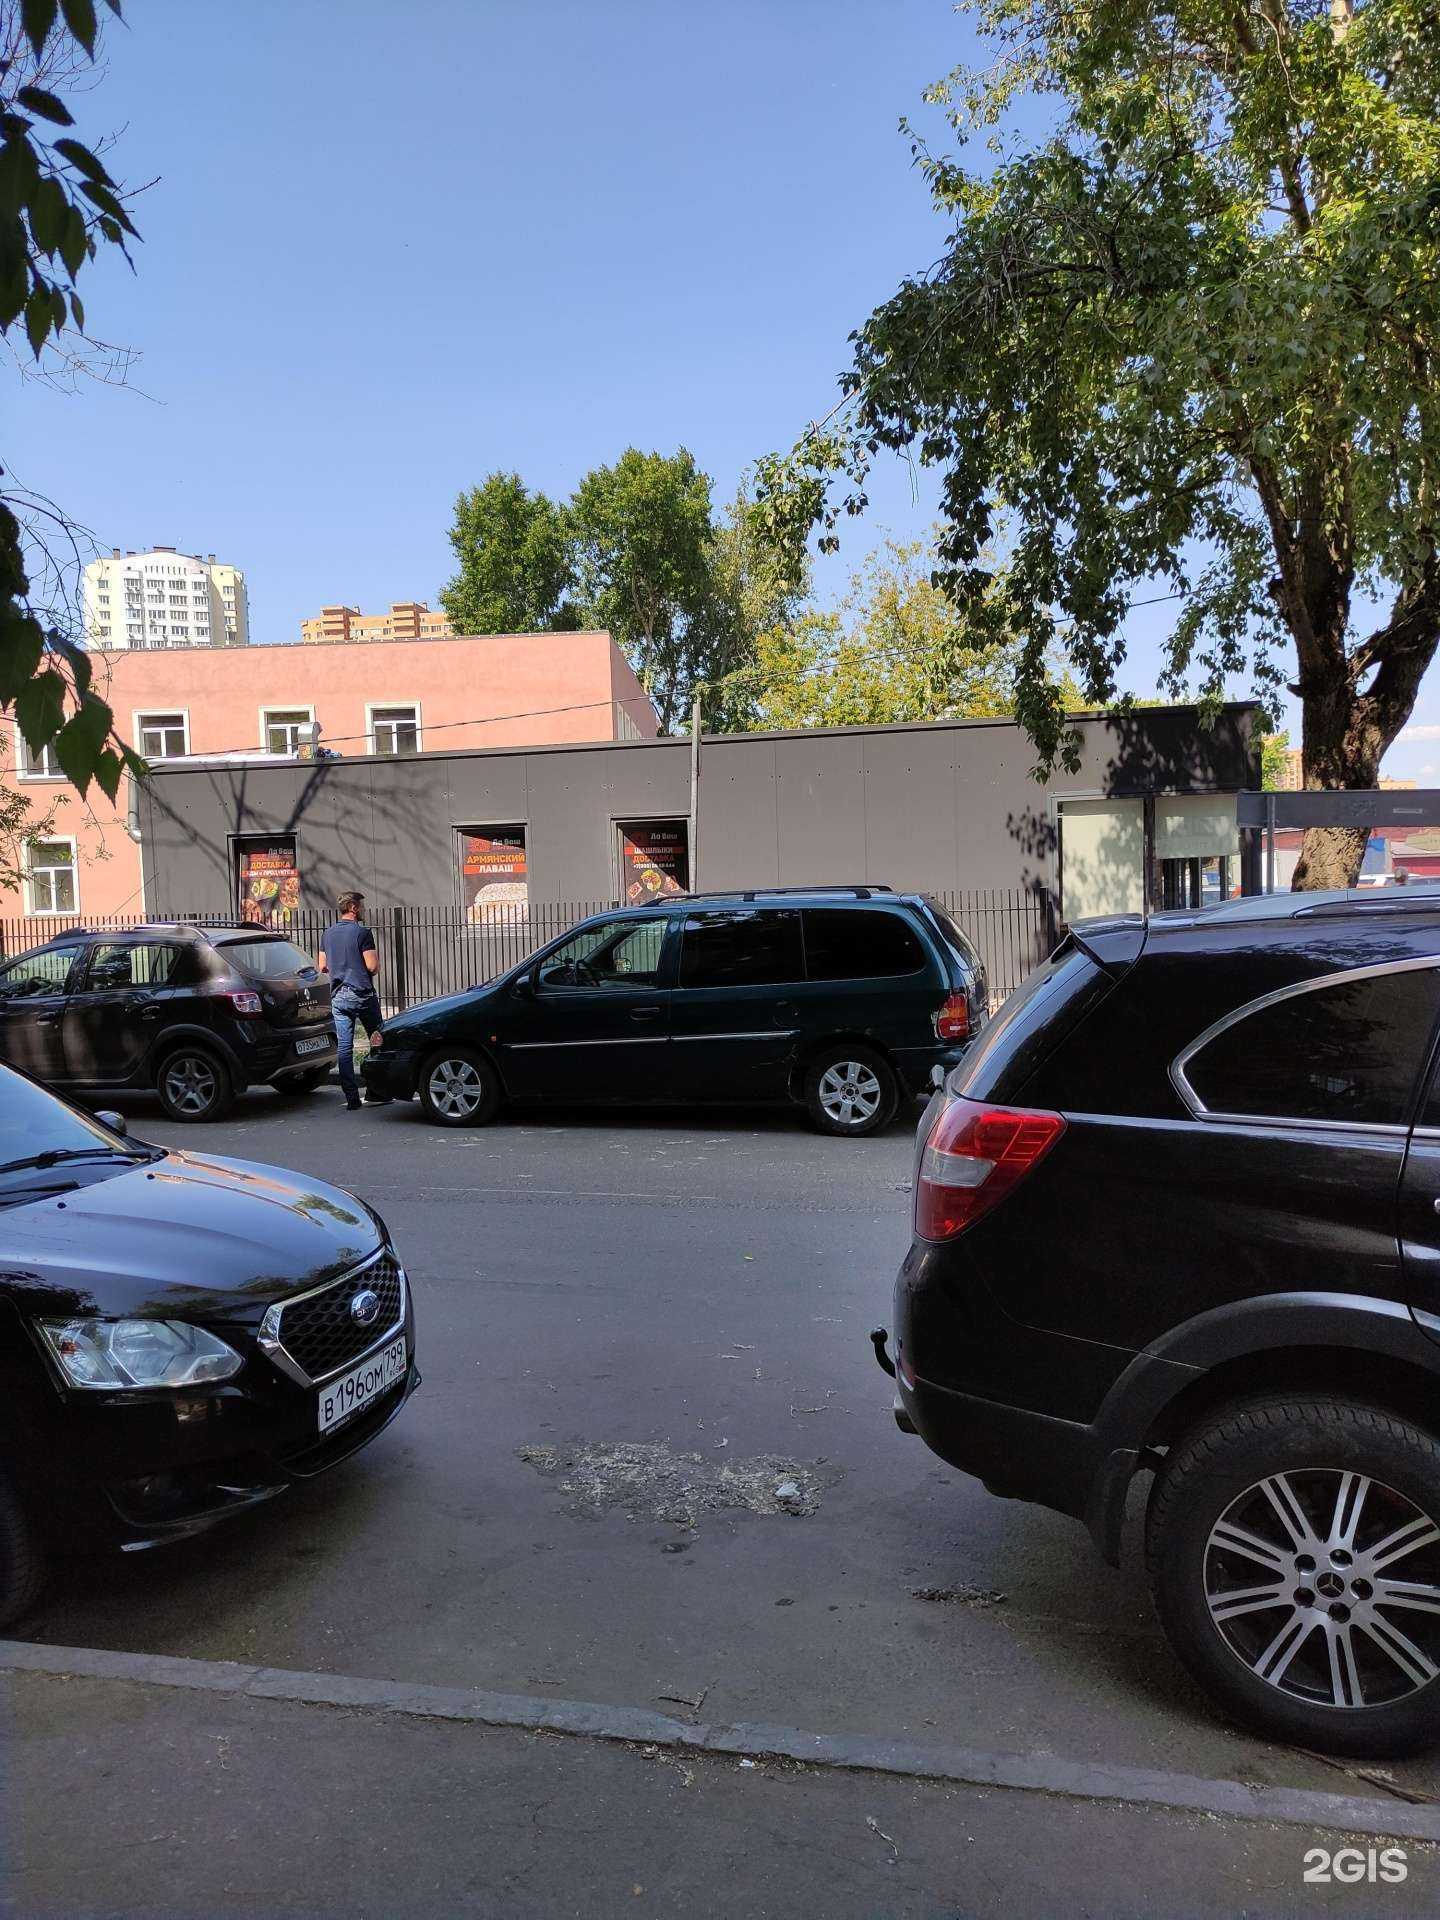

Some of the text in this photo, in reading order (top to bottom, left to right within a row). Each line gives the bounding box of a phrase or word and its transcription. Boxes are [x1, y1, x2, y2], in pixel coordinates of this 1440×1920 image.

[467, 853, 525, 864] АРМЯНСКИЙ
[633, 855, 673, 864] ДОСТАВКА
[251, 861, 291, 870] ДОСТАВКА
[479, 864, 514, 873] ЛАВАШ
[324, 1343, 403, 1423] В196ОМ 799
